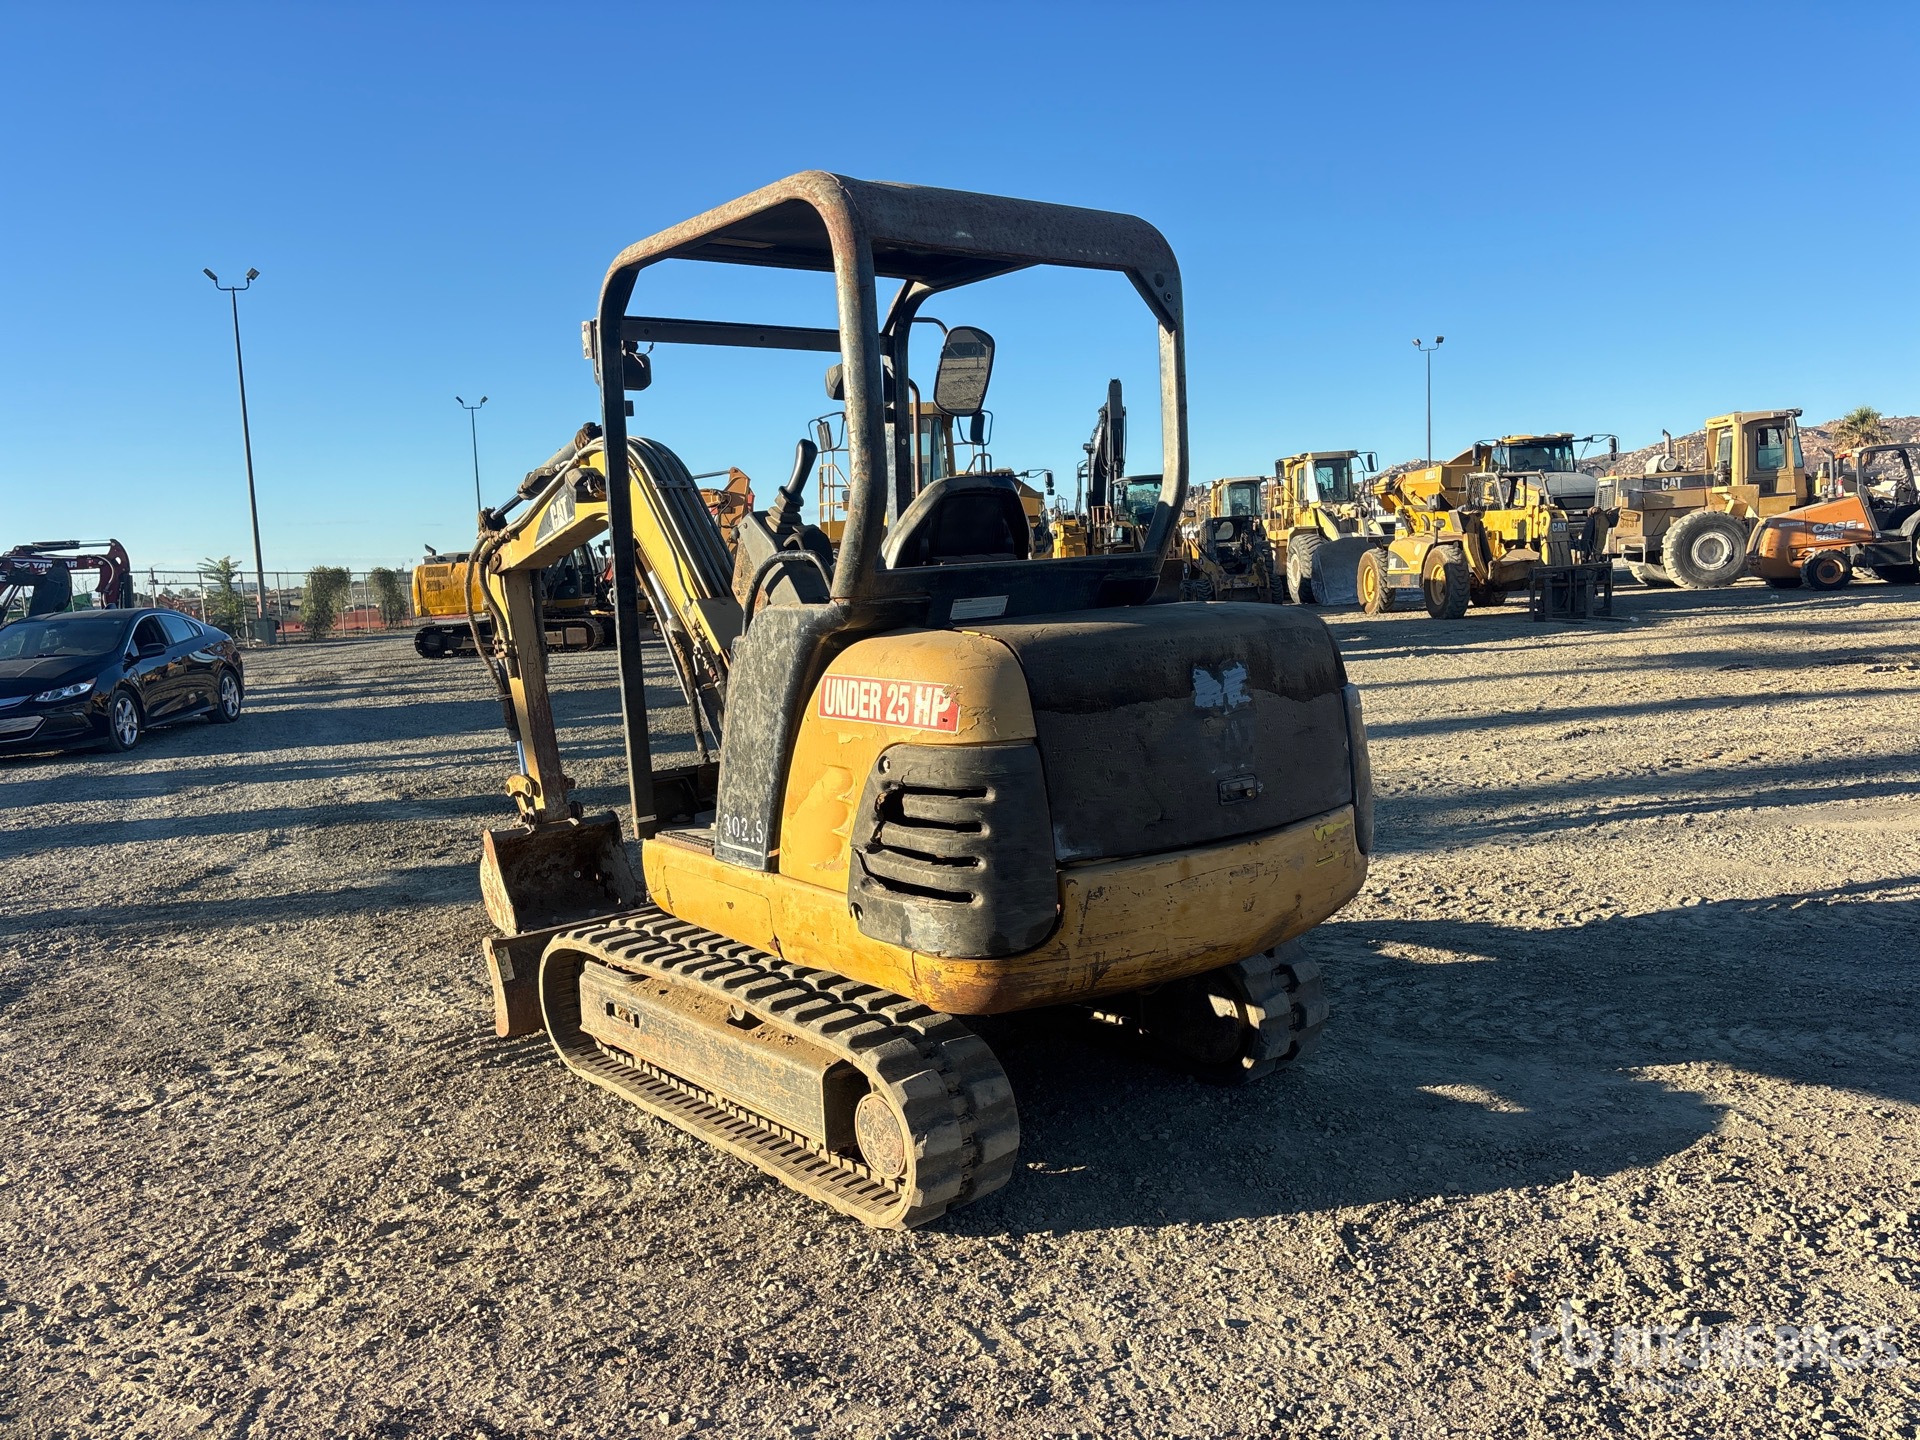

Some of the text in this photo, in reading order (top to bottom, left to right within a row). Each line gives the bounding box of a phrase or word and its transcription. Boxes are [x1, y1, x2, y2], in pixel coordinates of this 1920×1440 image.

[1661, 477, 1682, 491] CAT
[549, 495, 570, 529] CAT
[1552, 522, 1567, 532] CAT
[1812, 520, 1857, 534] CASE
[33, 561, 77, 569] YANAR
[824, 678, 951, 727] UNDER 25 HP
[723, 813, 763, 844] 302.5
